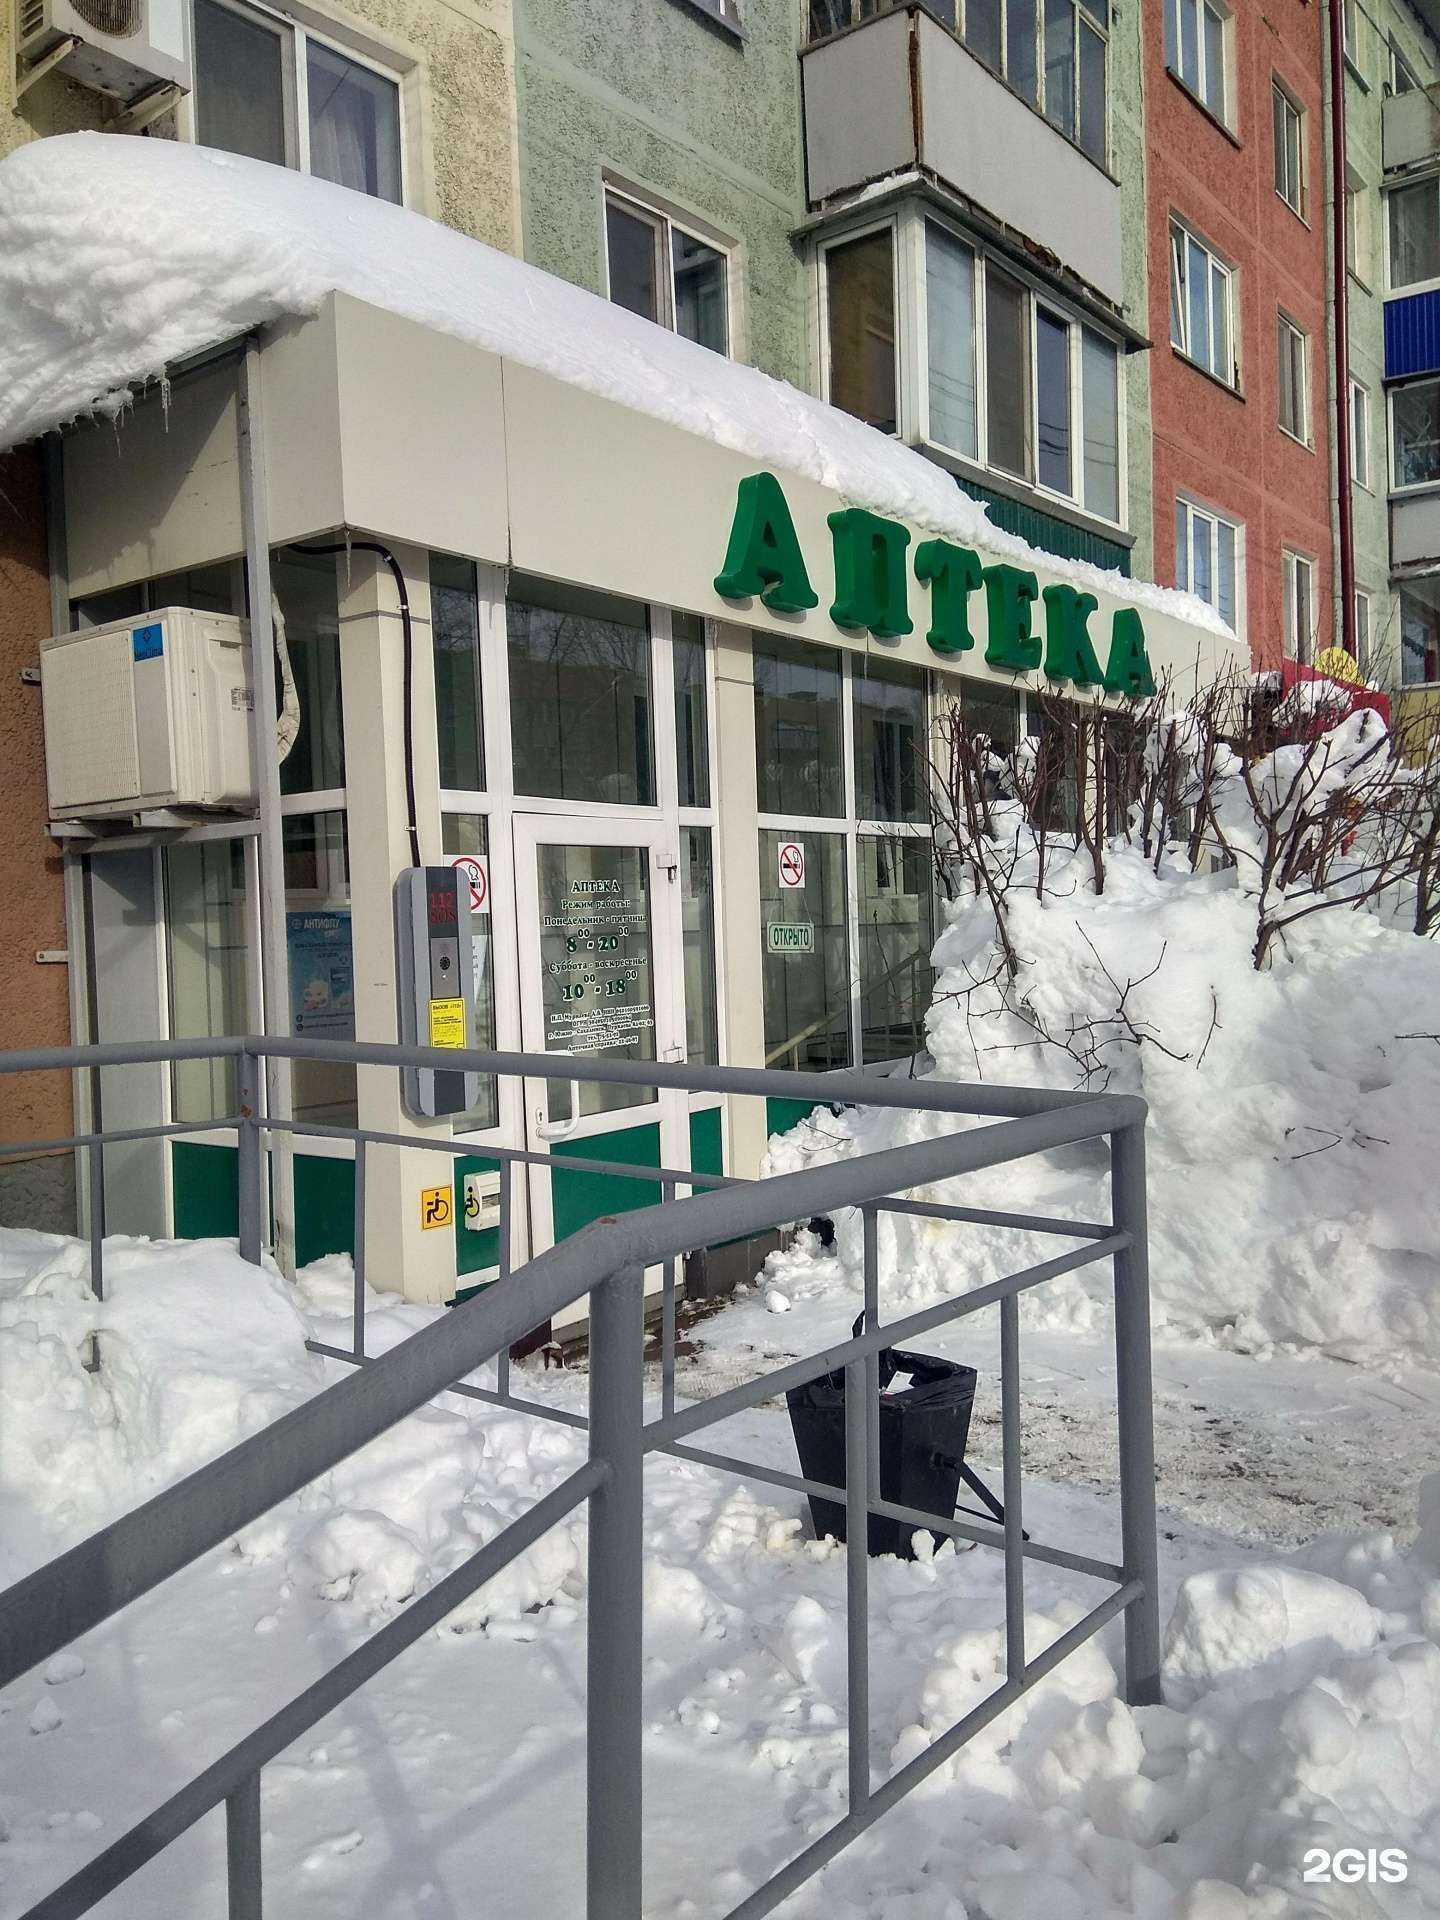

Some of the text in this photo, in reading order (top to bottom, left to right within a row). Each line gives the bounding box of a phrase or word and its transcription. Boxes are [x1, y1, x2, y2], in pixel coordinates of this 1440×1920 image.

[714, 472, 1156, 697] АПТЕКА
[571, 879, 620, 893] АПТЕКА
[561, 899, 592, 910] Режим
[544, 916, 605, 926] Понедельник
[774, 928, 808, 945] ОТКРЫТО
[549, 959, 588, 974] Суббота
[595, 957, 647, 969] воскресенье
